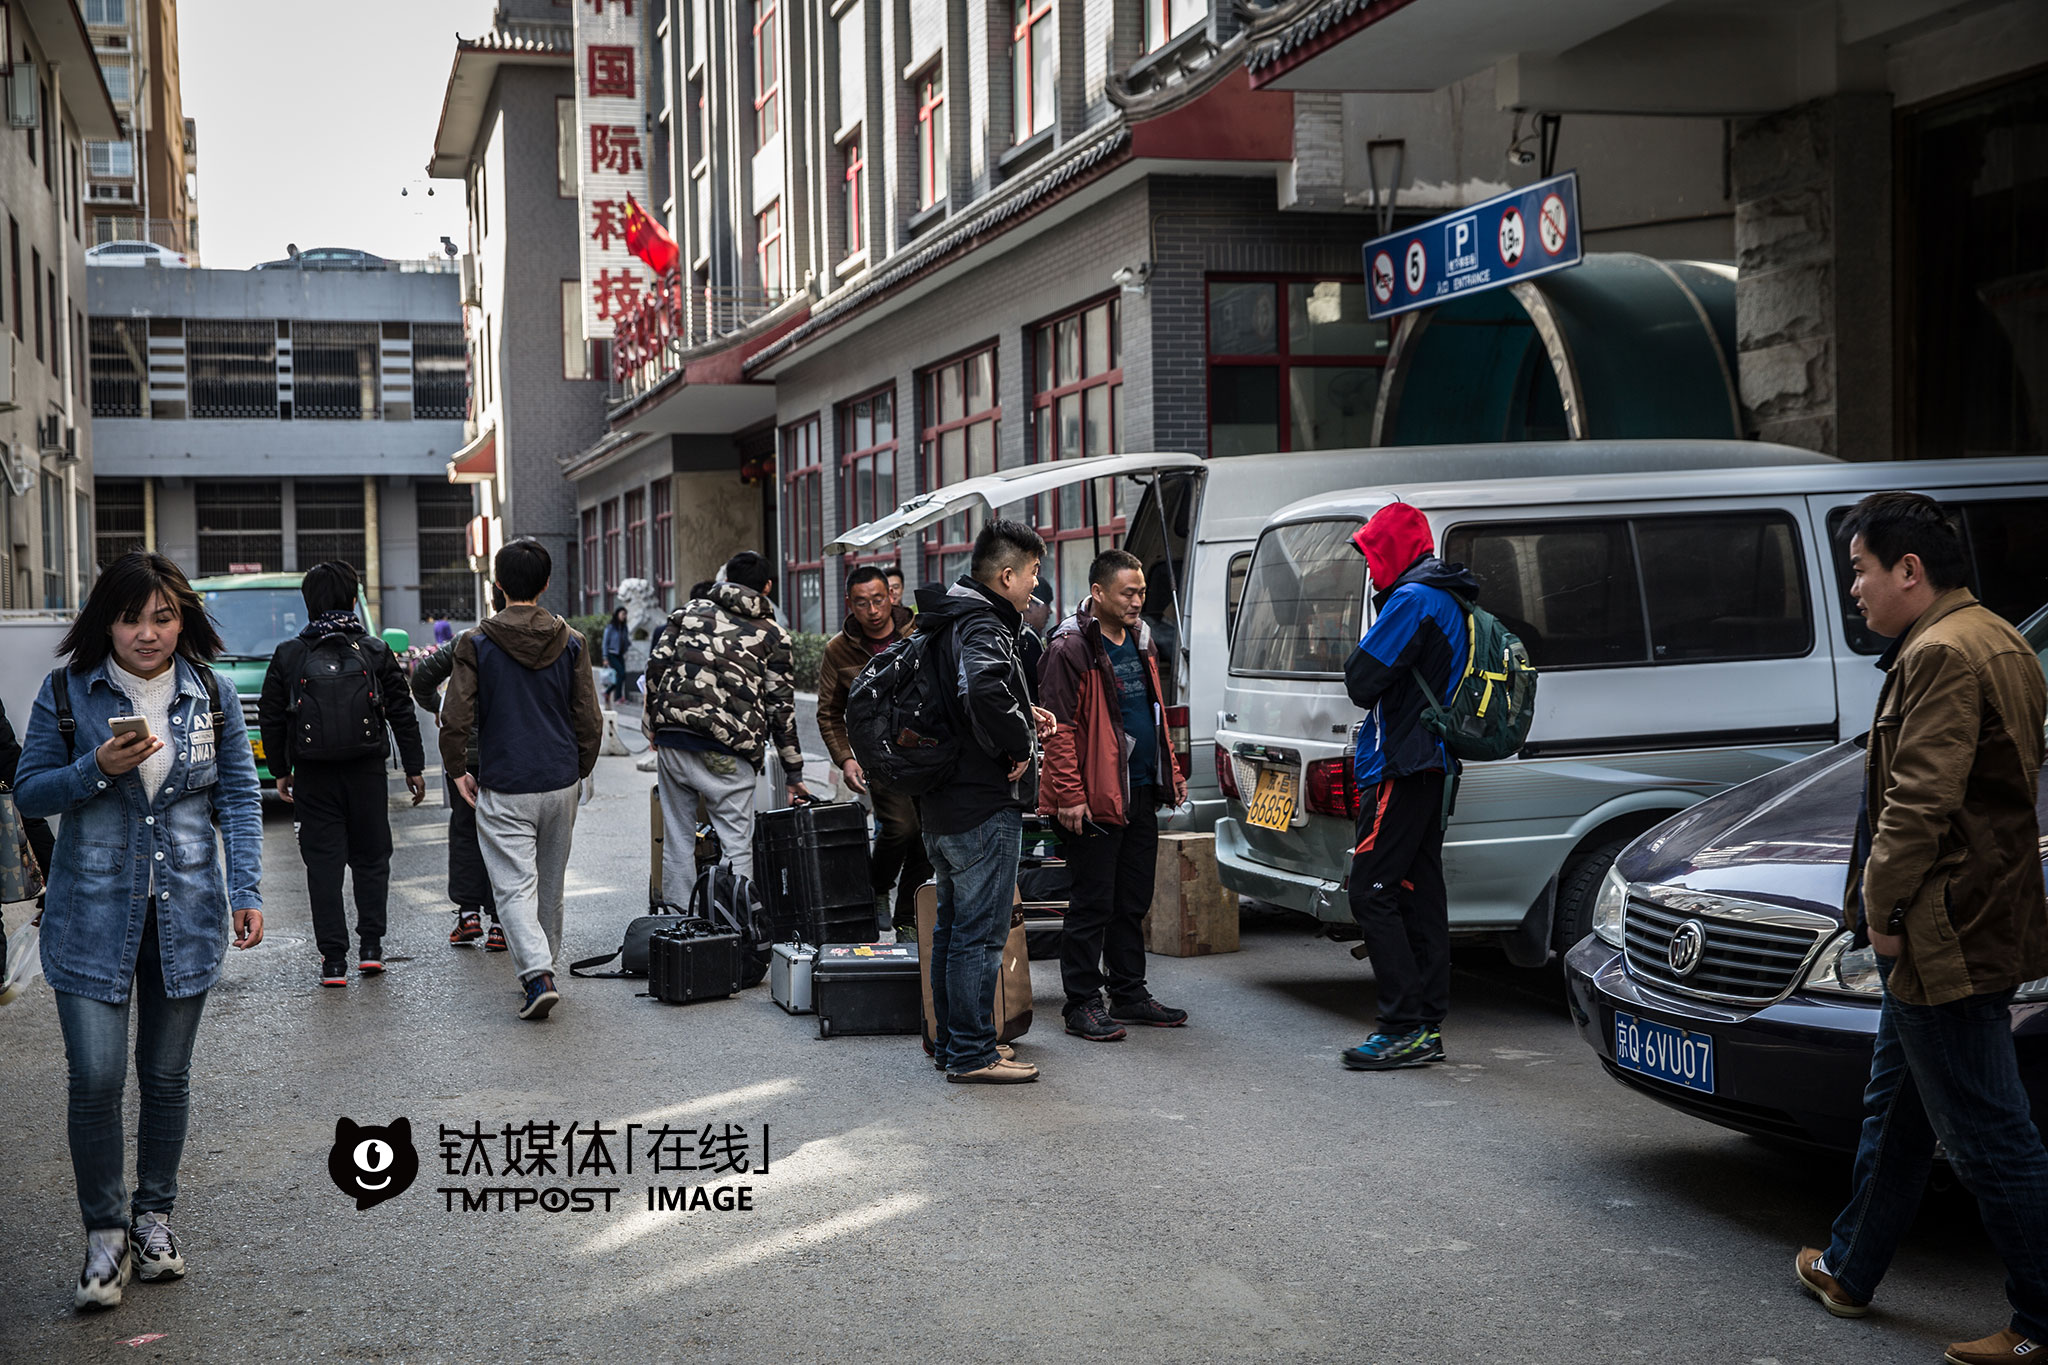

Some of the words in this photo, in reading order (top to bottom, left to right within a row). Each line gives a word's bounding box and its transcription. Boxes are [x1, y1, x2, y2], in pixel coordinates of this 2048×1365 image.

[586, 0, 645, 320] 国际科技
[1455, 222, 1469, 258] P
[1410, 251, 1421, 282] 5
[1435, 280, 1450, 296] 入口
[1453, 268, 1491, 291] ENTRANCE
[1250, 792, 1292, 827] 66859
